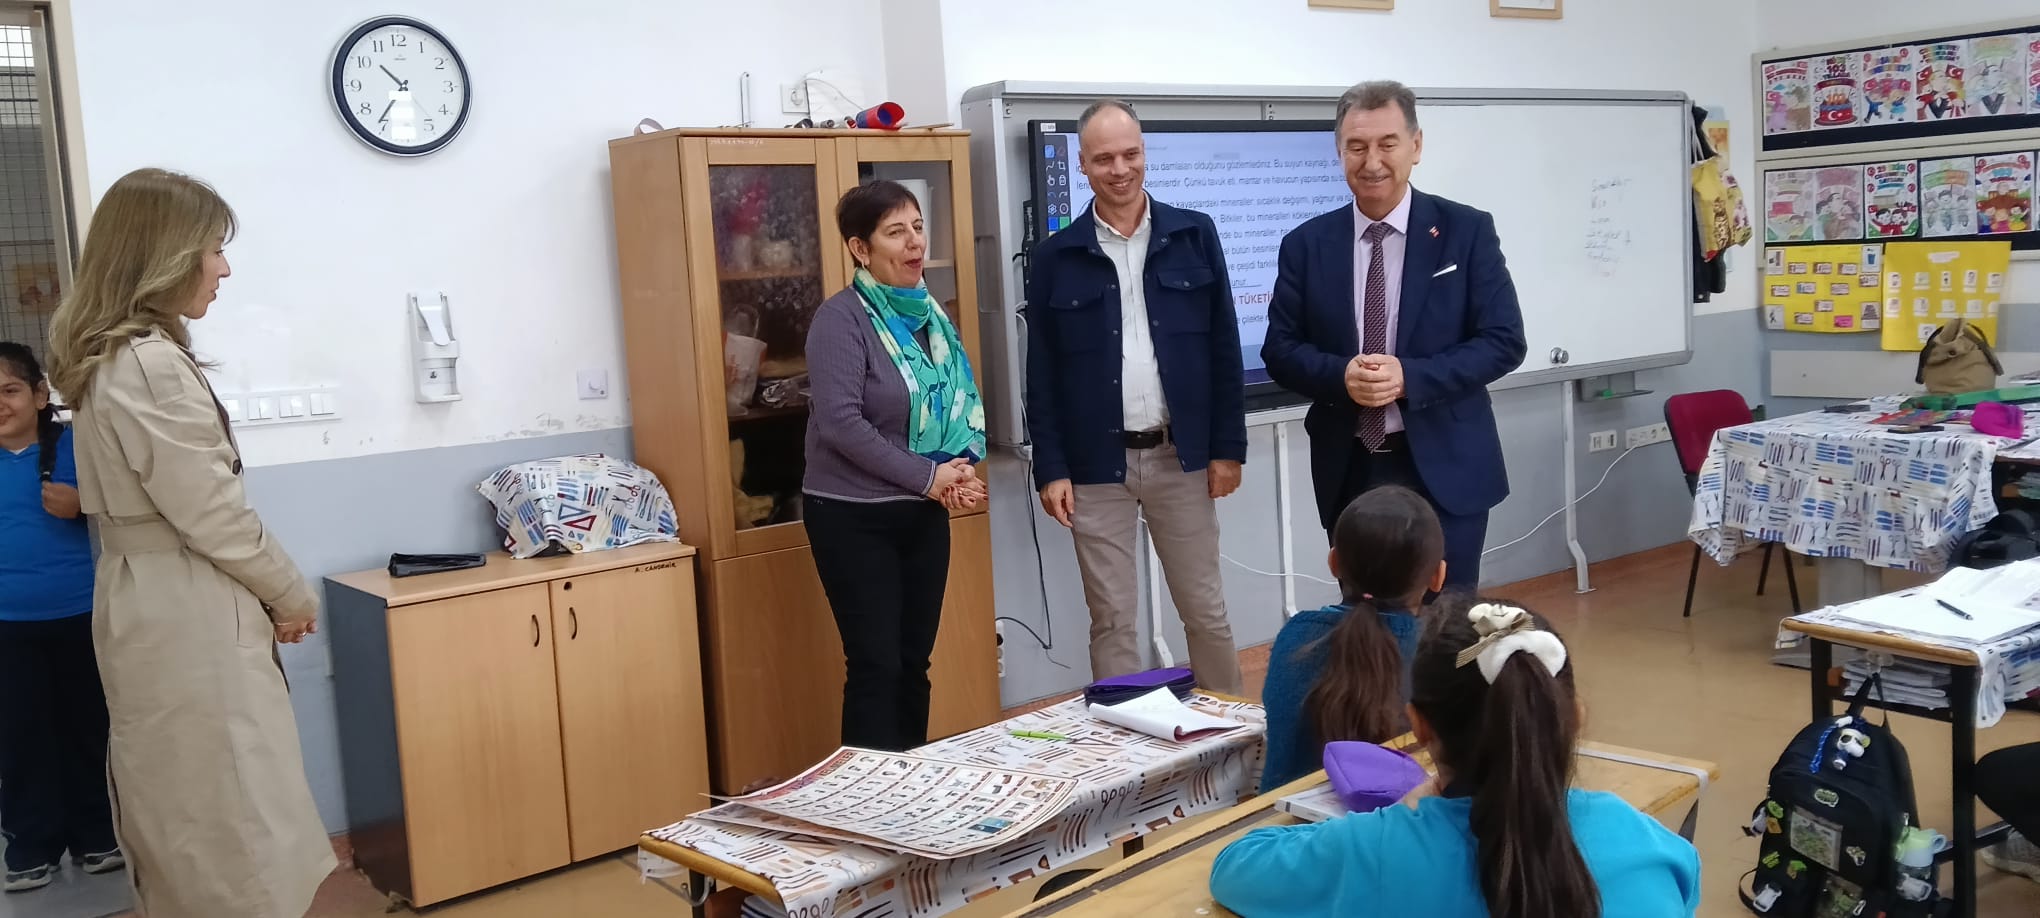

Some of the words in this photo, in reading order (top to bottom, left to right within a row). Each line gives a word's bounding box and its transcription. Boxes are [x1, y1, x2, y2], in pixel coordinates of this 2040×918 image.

[373, 40, 383, 53] 11
[391, 34, 407, 47] 12
[420, 41, 424, 54] 1
[357, 55, 372, 69] 10
[434, 57, 445, 70] 2
[350, 79, 362, 92] 9
[443, 80, 454, 93] 3
[360, 102, 372, 115] 8
[438, 103, 449, 116] 4
[379, 119, 389, 131] 7
[423, 118, 434, 132] 5
[1274, 159, 1283, 168] Bu
[1239, 291, 1273, 304] TÜKETİ
